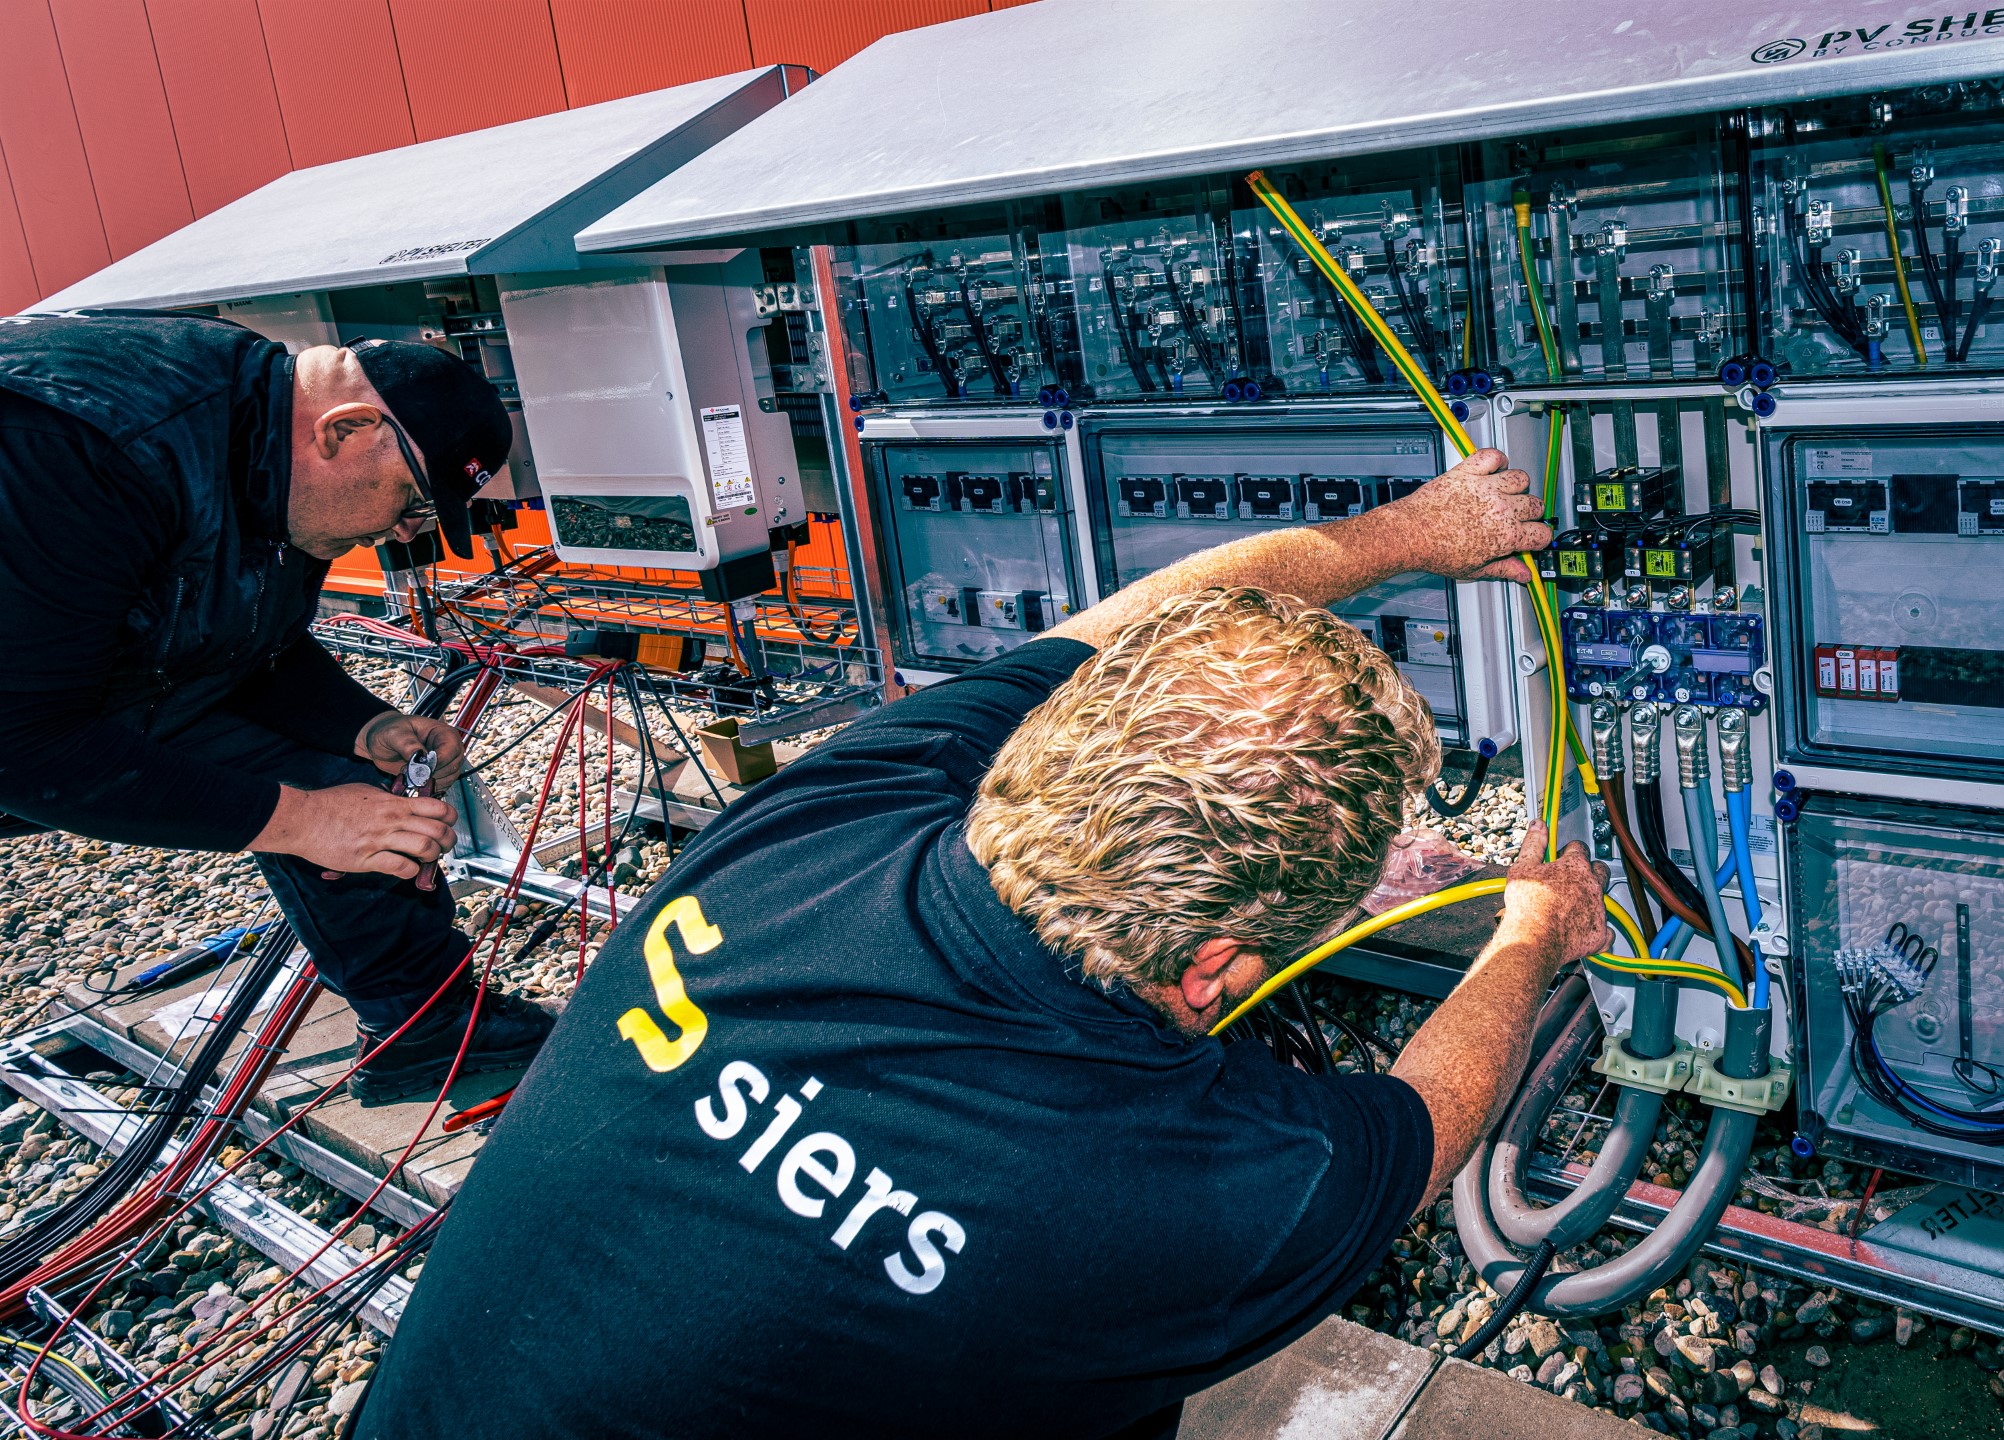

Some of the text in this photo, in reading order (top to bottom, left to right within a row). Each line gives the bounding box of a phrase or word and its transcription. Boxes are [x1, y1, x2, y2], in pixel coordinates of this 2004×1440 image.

[1818, 24, 1892, 49] PV
[1812, 46, 1848, 58] BY
[1590, 684, 1600, 694] L1
[1634, 688, 1645, 698] L2
[1677, 690, 1688, 700] L3
[694, 1060, 966, 1295] siers
